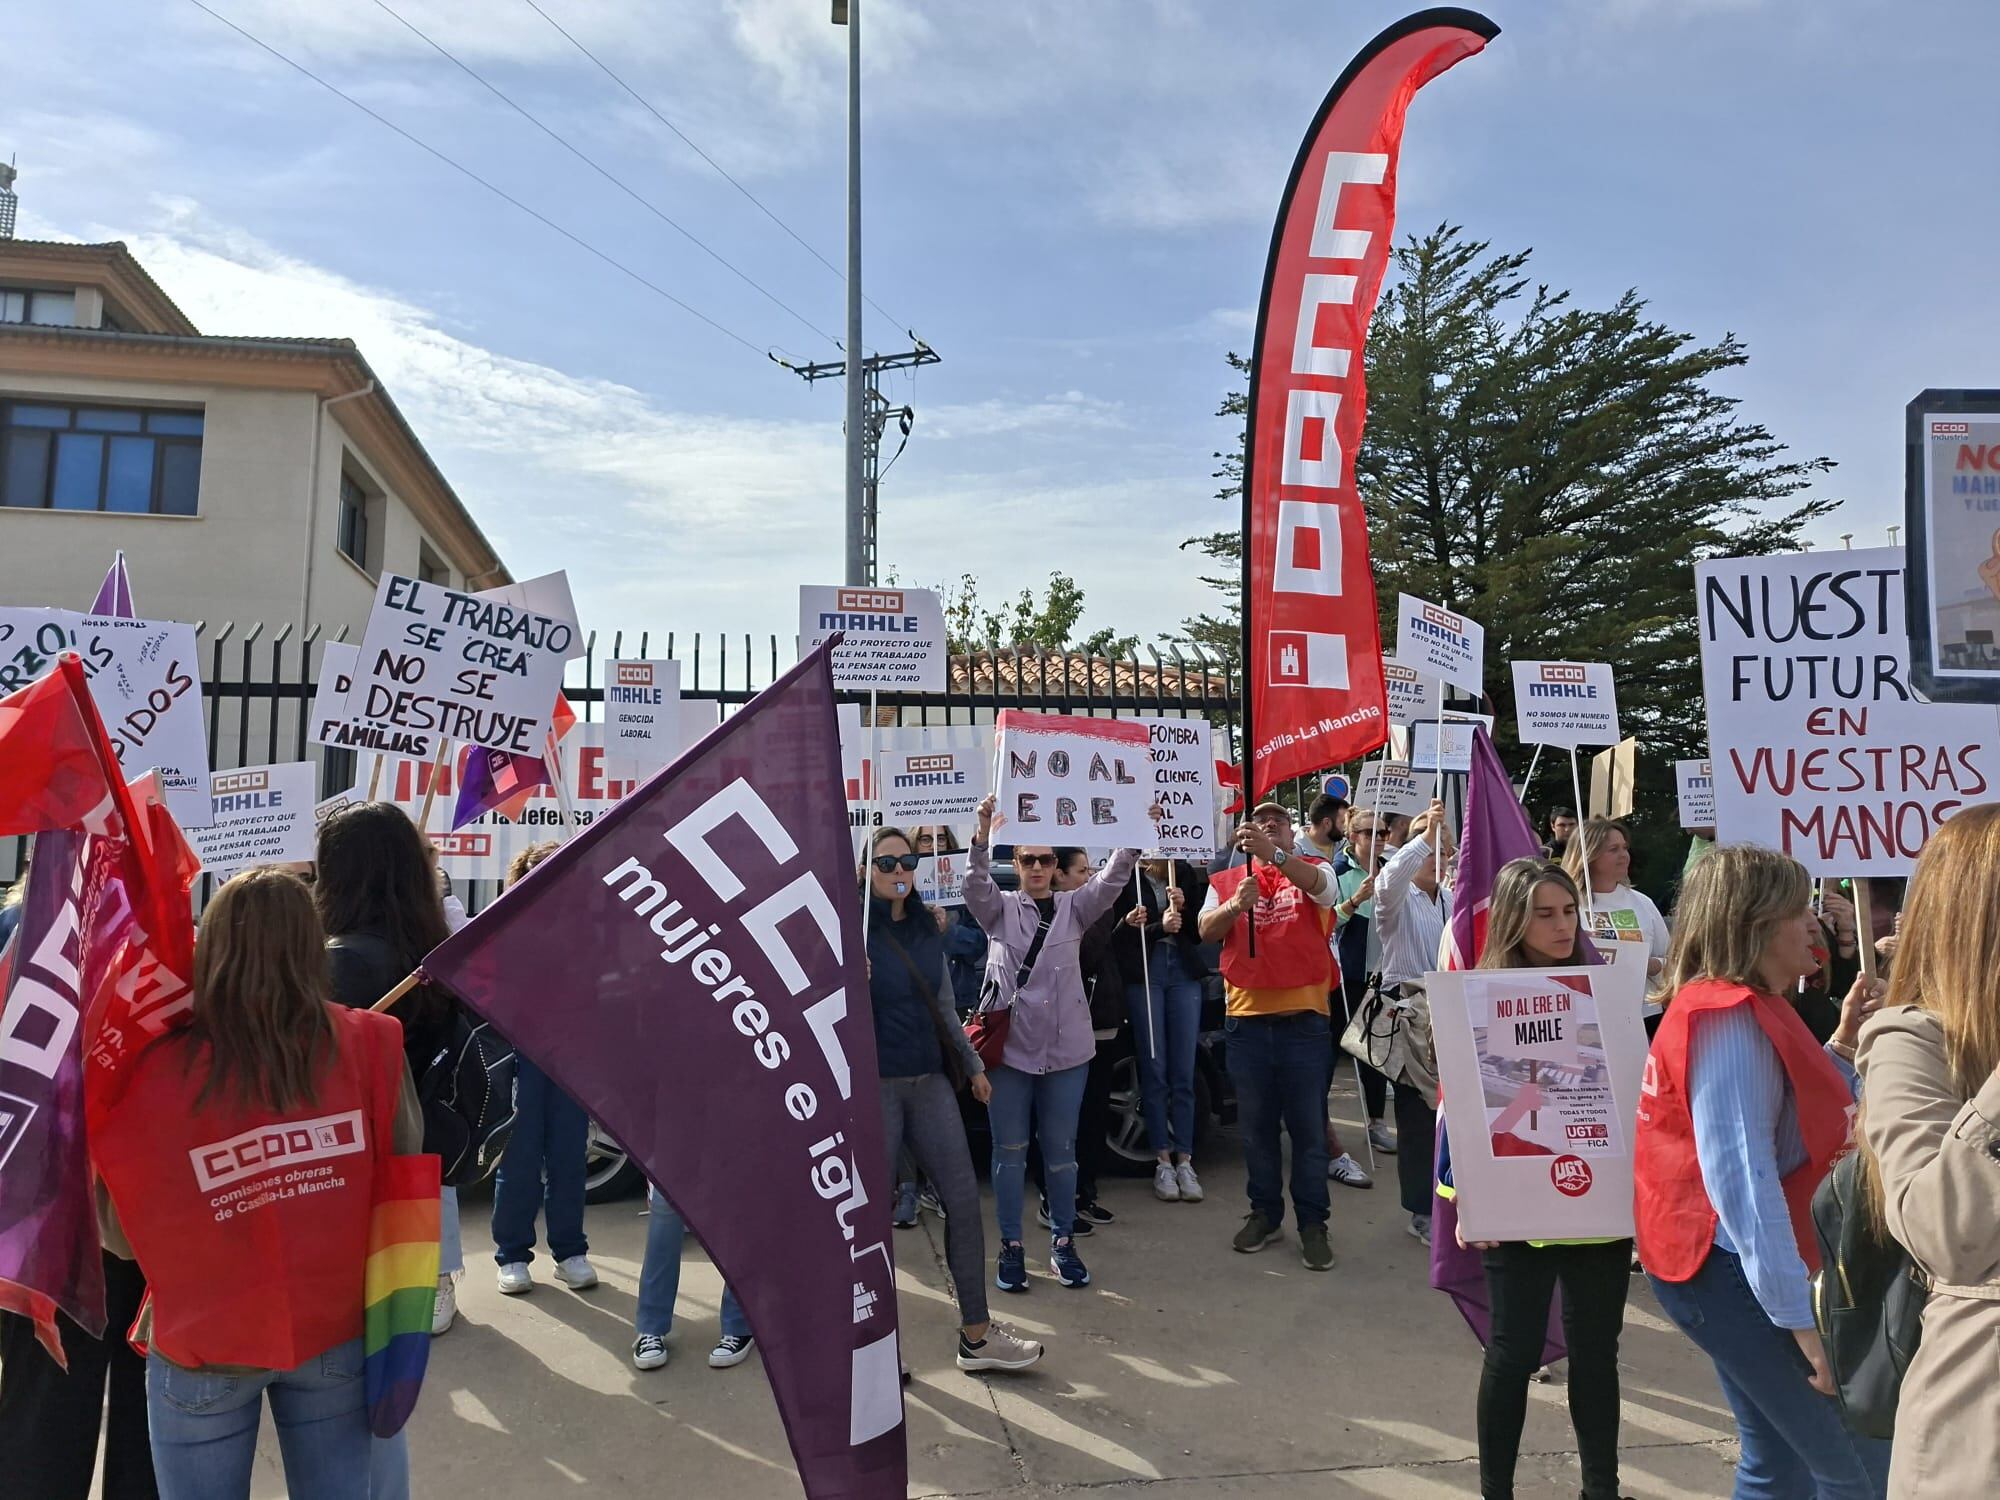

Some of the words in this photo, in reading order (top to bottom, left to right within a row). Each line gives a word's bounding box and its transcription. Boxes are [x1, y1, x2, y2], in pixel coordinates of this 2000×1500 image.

[1272, 152, 1389, 597] CCOO
[1933, 424, 1967, 432] CCOO
[842, 593, 899, 610] CCOO
[1705, 569, 1909, 644] NUEST
[384, 576, 426, 615] EL
[444, 592, 572, 654] TRABAJO
[820, 613, 918, 633] MAHLE
[1425, 608, 1460, 631] CCOO
[114, 621, 147, 629] EXTRAS
[1410, 616, 1470, 652] MAHLE
[403, 623, 446, 652] SE
[860, 639, 910, 648] PROYECTO
[1411, 632, 1429, 644] ESTO
[1430, 640, 1441, 648] NO
[1441, 643, 1450, 652] ES
[1450, 647, 1461, 656] UN
[1461, 651, 1474, 662] ERE
[871, 651, 927, 660] TRABAJADO
[1427, 656, 1458, 673] MASACRE
[1430, 648, 1440, 656] ES
[1440, 652, 1454, 663] UNA
[373, 648, 425, 684] NO
[450, 670, 497, 700] SE
[619, 668, 651, 682] CCOO
[832, 662, 845, 670] RA
[847, 662, 886, 671] PENSAR
[888, 664, 917, 672] COMO
[1543, 667, 1583, 681] CCOO
[832, 674, 878, 682] CHARNOS
[881, 674, 892, 682] AL
[894, 675, 920, 683] PARO
[1731, 655, 1931, 704] FUTUR
[610, 686, 662, 705] MAHLE
[1529, 683, 1597, 699] MAHLE
[365, 684, 538, 753] DESTRUYE
[618, 714, 654, 724] GENOCIDA
[1806, 707, 1868, 736] EN
[319, 720, 429, 757] FAMILIAS
[620, 729, 653, 739] LABORAL
[1255, 725, 1318, 760] astilla-La
[1317, 703, 1381, 734] Mancha
[910, 757, 951, 770] CCOO
[1010, 750, 1070, 778] NO
[1088, 752, 1135, 784] AL
[1729, 744, 1987, 797] VUESTRAS
[215, 772, 265, 791] CCOO
[894, 771, 965, 788] MAHLE
[938, 806, 974, 814] FAMILIAS
[1018, 793, 1118, 826] ERE
[229, 815, 275, 828] PROYECTO
[277, 812, 297, 821] QUE
[197, 832, 223, 843] MAHLE
[224, 831, 236, 839] HA
[237, 824, 291, 836] TRABAJADO
[203, 845, 218, 854] ERA
[219, 839, 252, 851] PENSAR
[253, 836, 281, 846] COMO
[202, 851, 244, 864] ECHARNOS
[245, 850, 257, 858] AL
[259, 847, 285, 857] PARO
[602, 856, 791, 1070] mujeres
[785, 1082, 818, 1121] e
[1497, 999, 1513, 1018] NO
[1516, 998, 1531, 1016] AL
[1533, 996, 1553, 1014] ERE
[1556, 993, 1571, 1011] EN
[1515, 1018, 1563, 1046] MAHLE
[1567, 1126, 1593, 1138] UGT
[203, 1128, 314, 1180] CCOO
[1554, 1161, 1585, 1180] UGT
[210, 1175, 281, 1208] comisiones
[284, 1165, 334, 1183] obreras
[214, 1205, 233, 1222] de
[297, 1176, 346, 1195] Mancha
